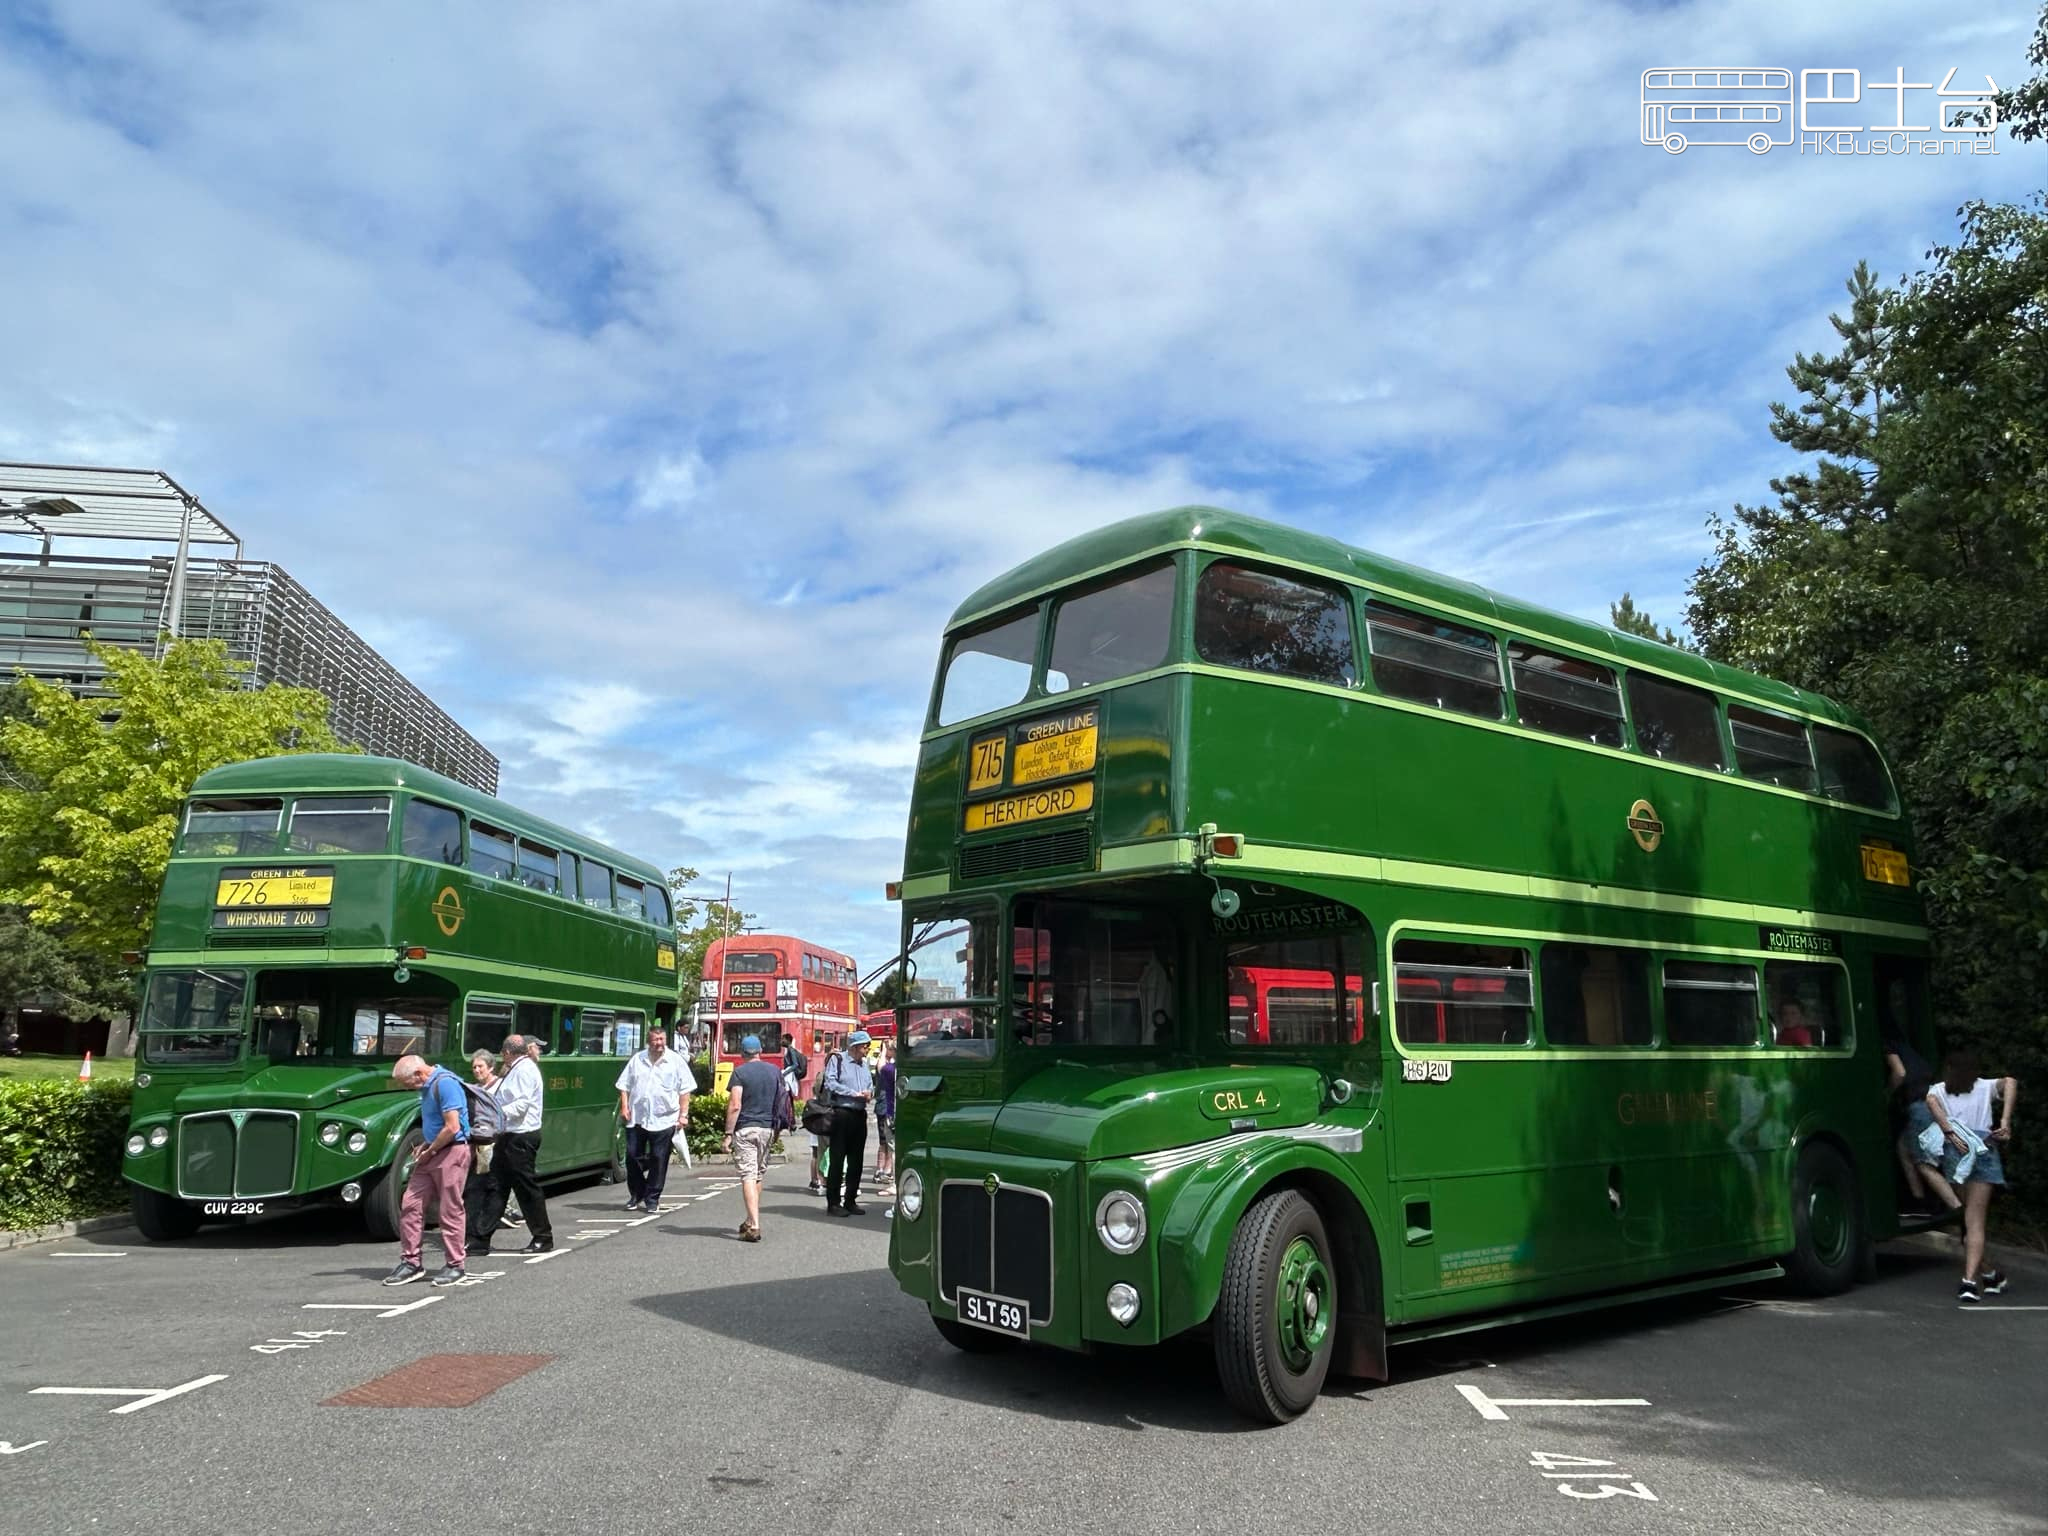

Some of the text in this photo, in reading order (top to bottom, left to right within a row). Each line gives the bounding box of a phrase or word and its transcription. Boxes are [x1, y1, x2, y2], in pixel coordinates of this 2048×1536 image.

[1027, 711, 1094, 742] GREEN LINE
[976, 740, 1003, 782] 715
[983, 788, 1076, 826] HERTFORD
[250, 869, 307, 879] GREEN LINE
[225, 880, 268, 905] 726
[226, 911, 316, 927] WHIPSNADE ZOO
[1212, 905, 1348, 934] ROUTEMASTER
[1769, 932, 1833, 951] ROUTEMASTER
[1214, 1089, 1267, 1111] CRL 4
[204, 1202, 264, 1215] CUV 229C
[967, 1296, 1021, 1329] SLT 59
